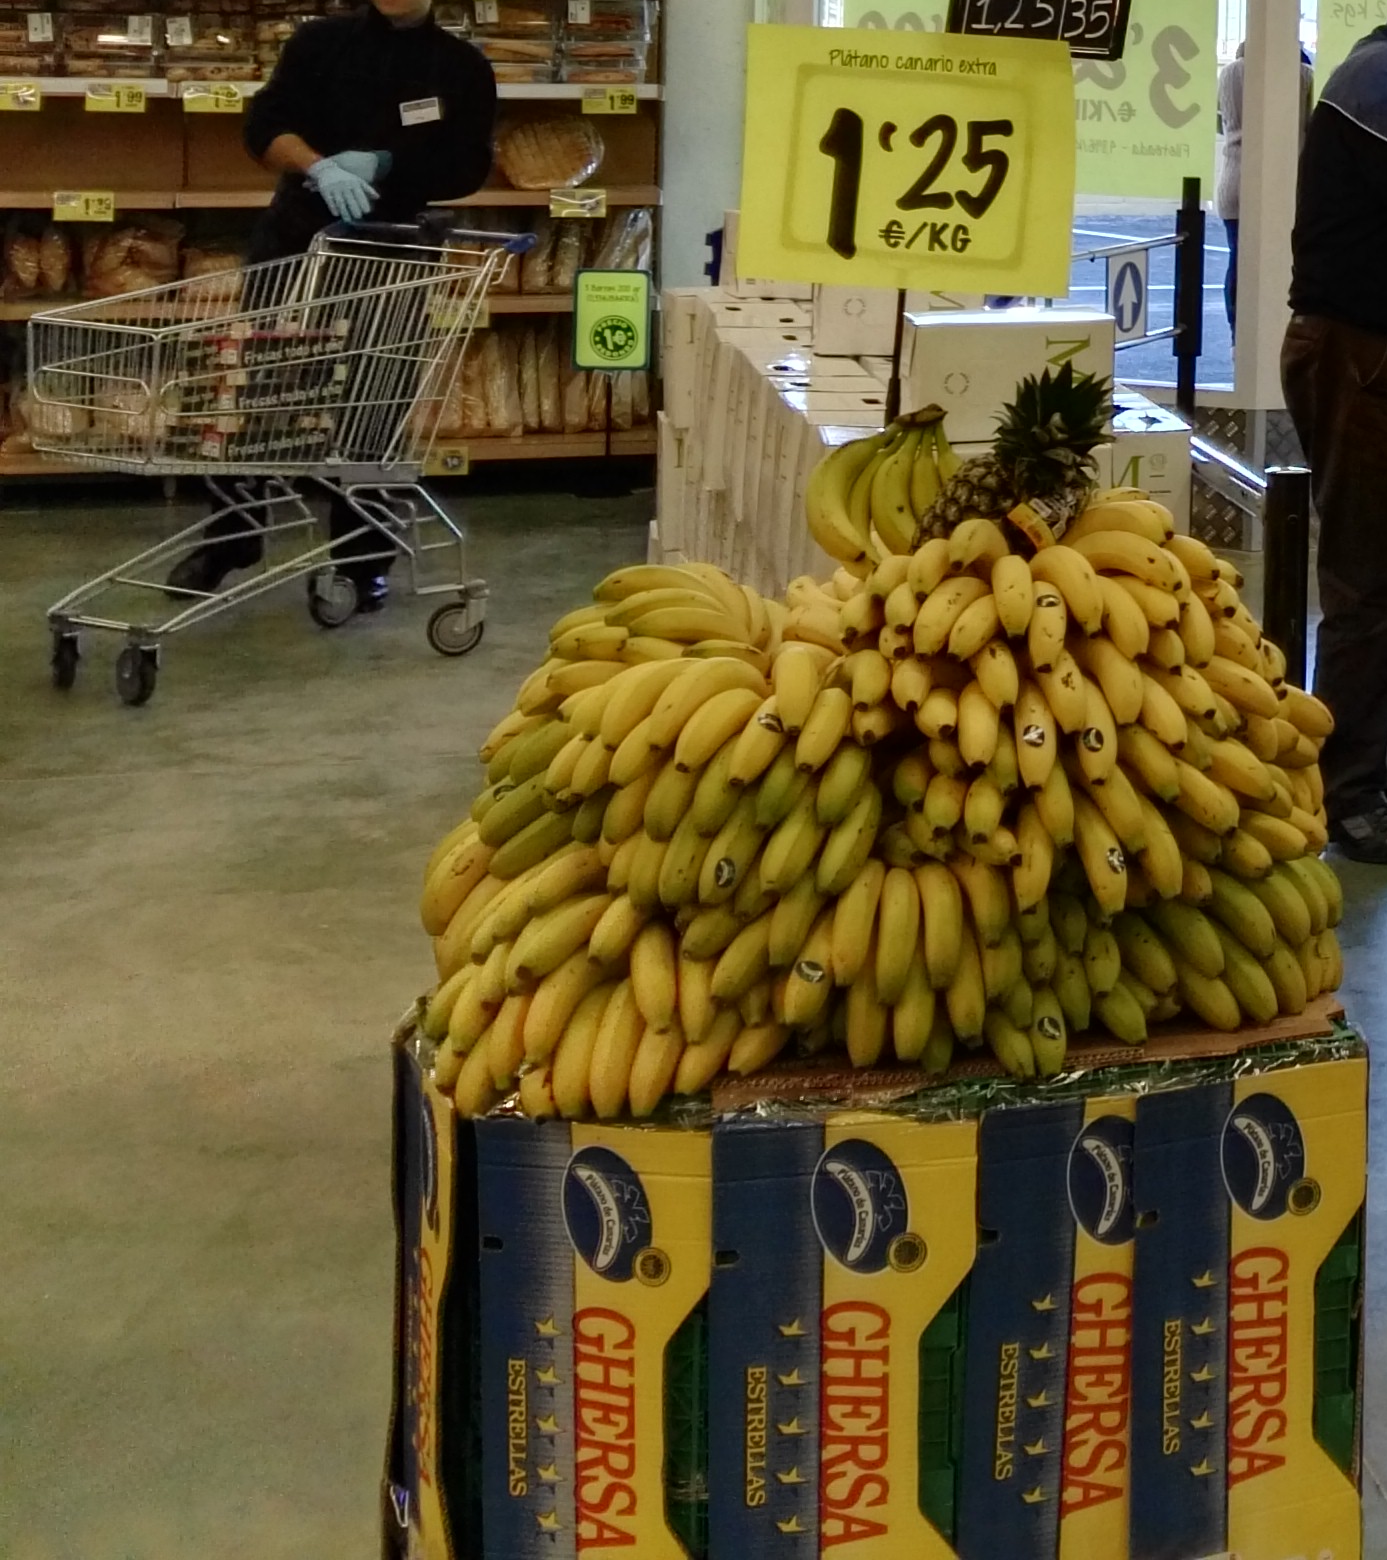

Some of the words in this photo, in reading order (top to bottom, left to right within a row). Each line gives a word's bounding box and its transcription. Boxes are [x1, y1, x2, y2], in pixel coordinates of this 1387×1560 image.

[828, 48, 890, 71] Plátano
[894, 51, 955, 74] canario
[958, 55, 998, 77] extra
[878, 221, 972, 254] €/KG
[507, 1357, 527, 1498] ESTRELLAS
[571, 1305, 640, 1552] GHERSA
[745, 1364, 768, 1509] ESTRELLAS
[820, 1298, 892, 1544] GHERSA
[994, 1340, 1020, 1483] ESTRELLAS
[1059, 1270, 1134, 1519] GHERSA
[1162, 1316, 1182, 1456] ESTRELLAS
[1227, 1244, 1290, 1490] GHERSA
